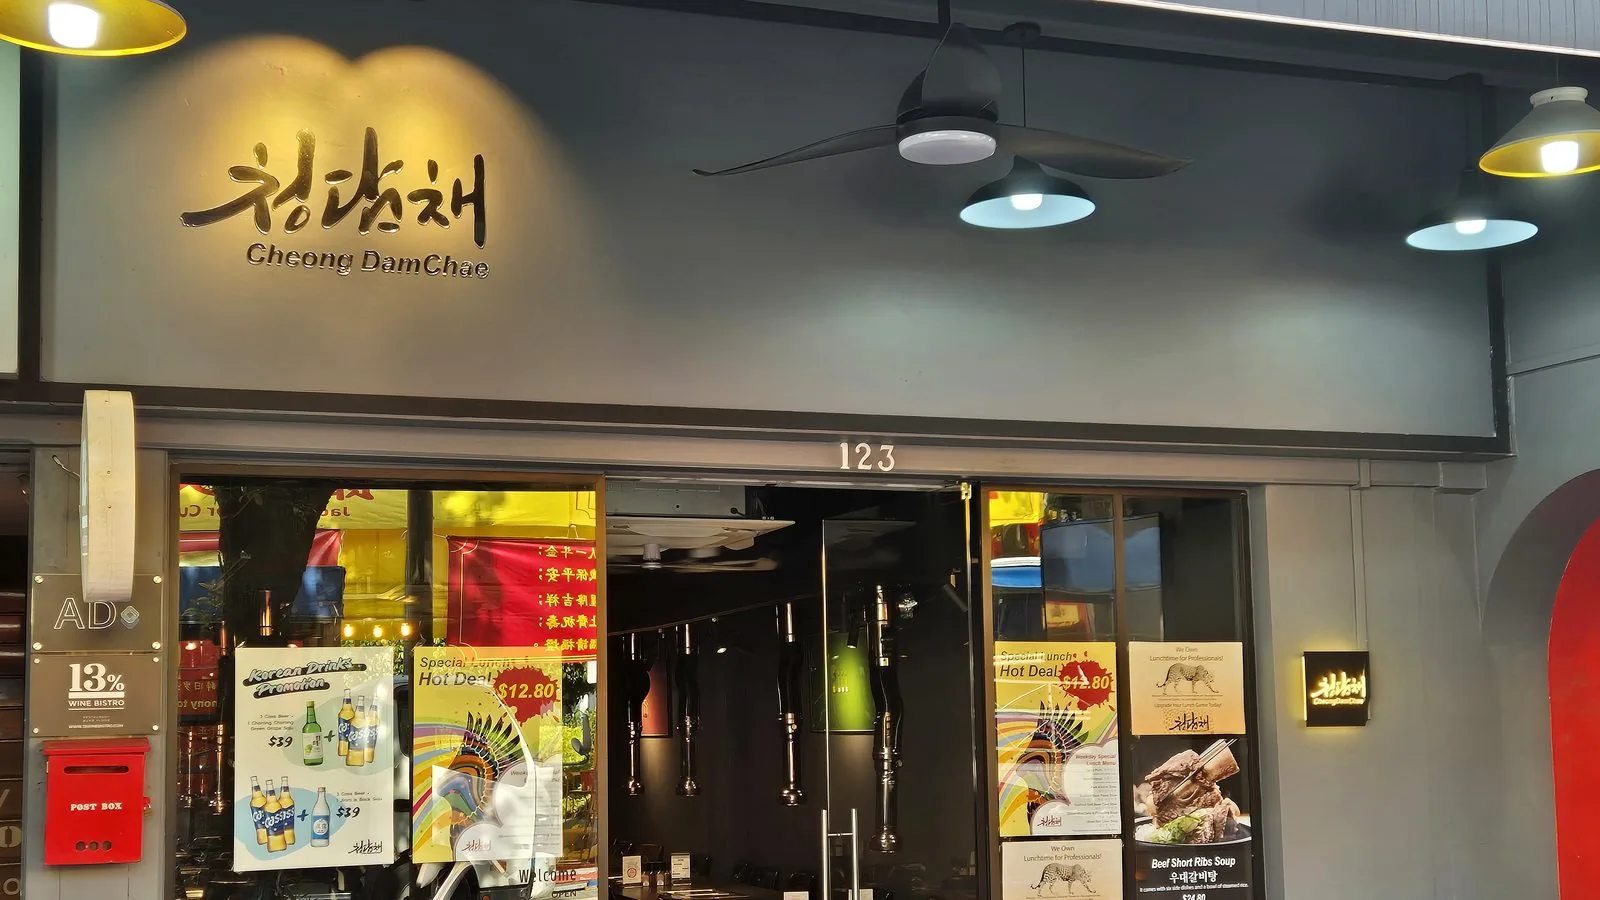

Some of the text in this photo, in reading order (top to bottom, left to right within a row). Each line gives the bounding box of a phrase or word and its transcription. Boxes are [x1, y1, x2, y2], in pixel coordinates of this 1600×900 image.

[180, 127, 485, 249] 청담채
[246, 242, 490, 278] Cheong DamChae
[840, 442, 895, 472] 123
[420, 657, 466, 670] Special
[1000, 651, 1037, 662] Special
[68, 663, 125, 691] 13%
[249, 657, 352, 683] Korean Drinks
[1000, 665, 1058, 677] Hot Deal
[419, 672, 492, 686] Hot Deal
[1063, 676, 1110, 690] $12.80
[257, 677, 325, 696] Promotion
[498, 683, 555, 698] $12.80
[269, 736, 292, 748] $39
[70, 802, 122, 811] POST BOX
[336, 806, 360, 818] $39
[1152, 856, 1236, 869] Beef Short Ribs Soup
[519, 869, 577, 883] Welcome
[1170, 870, 1218, 884] 우대갈비탕
